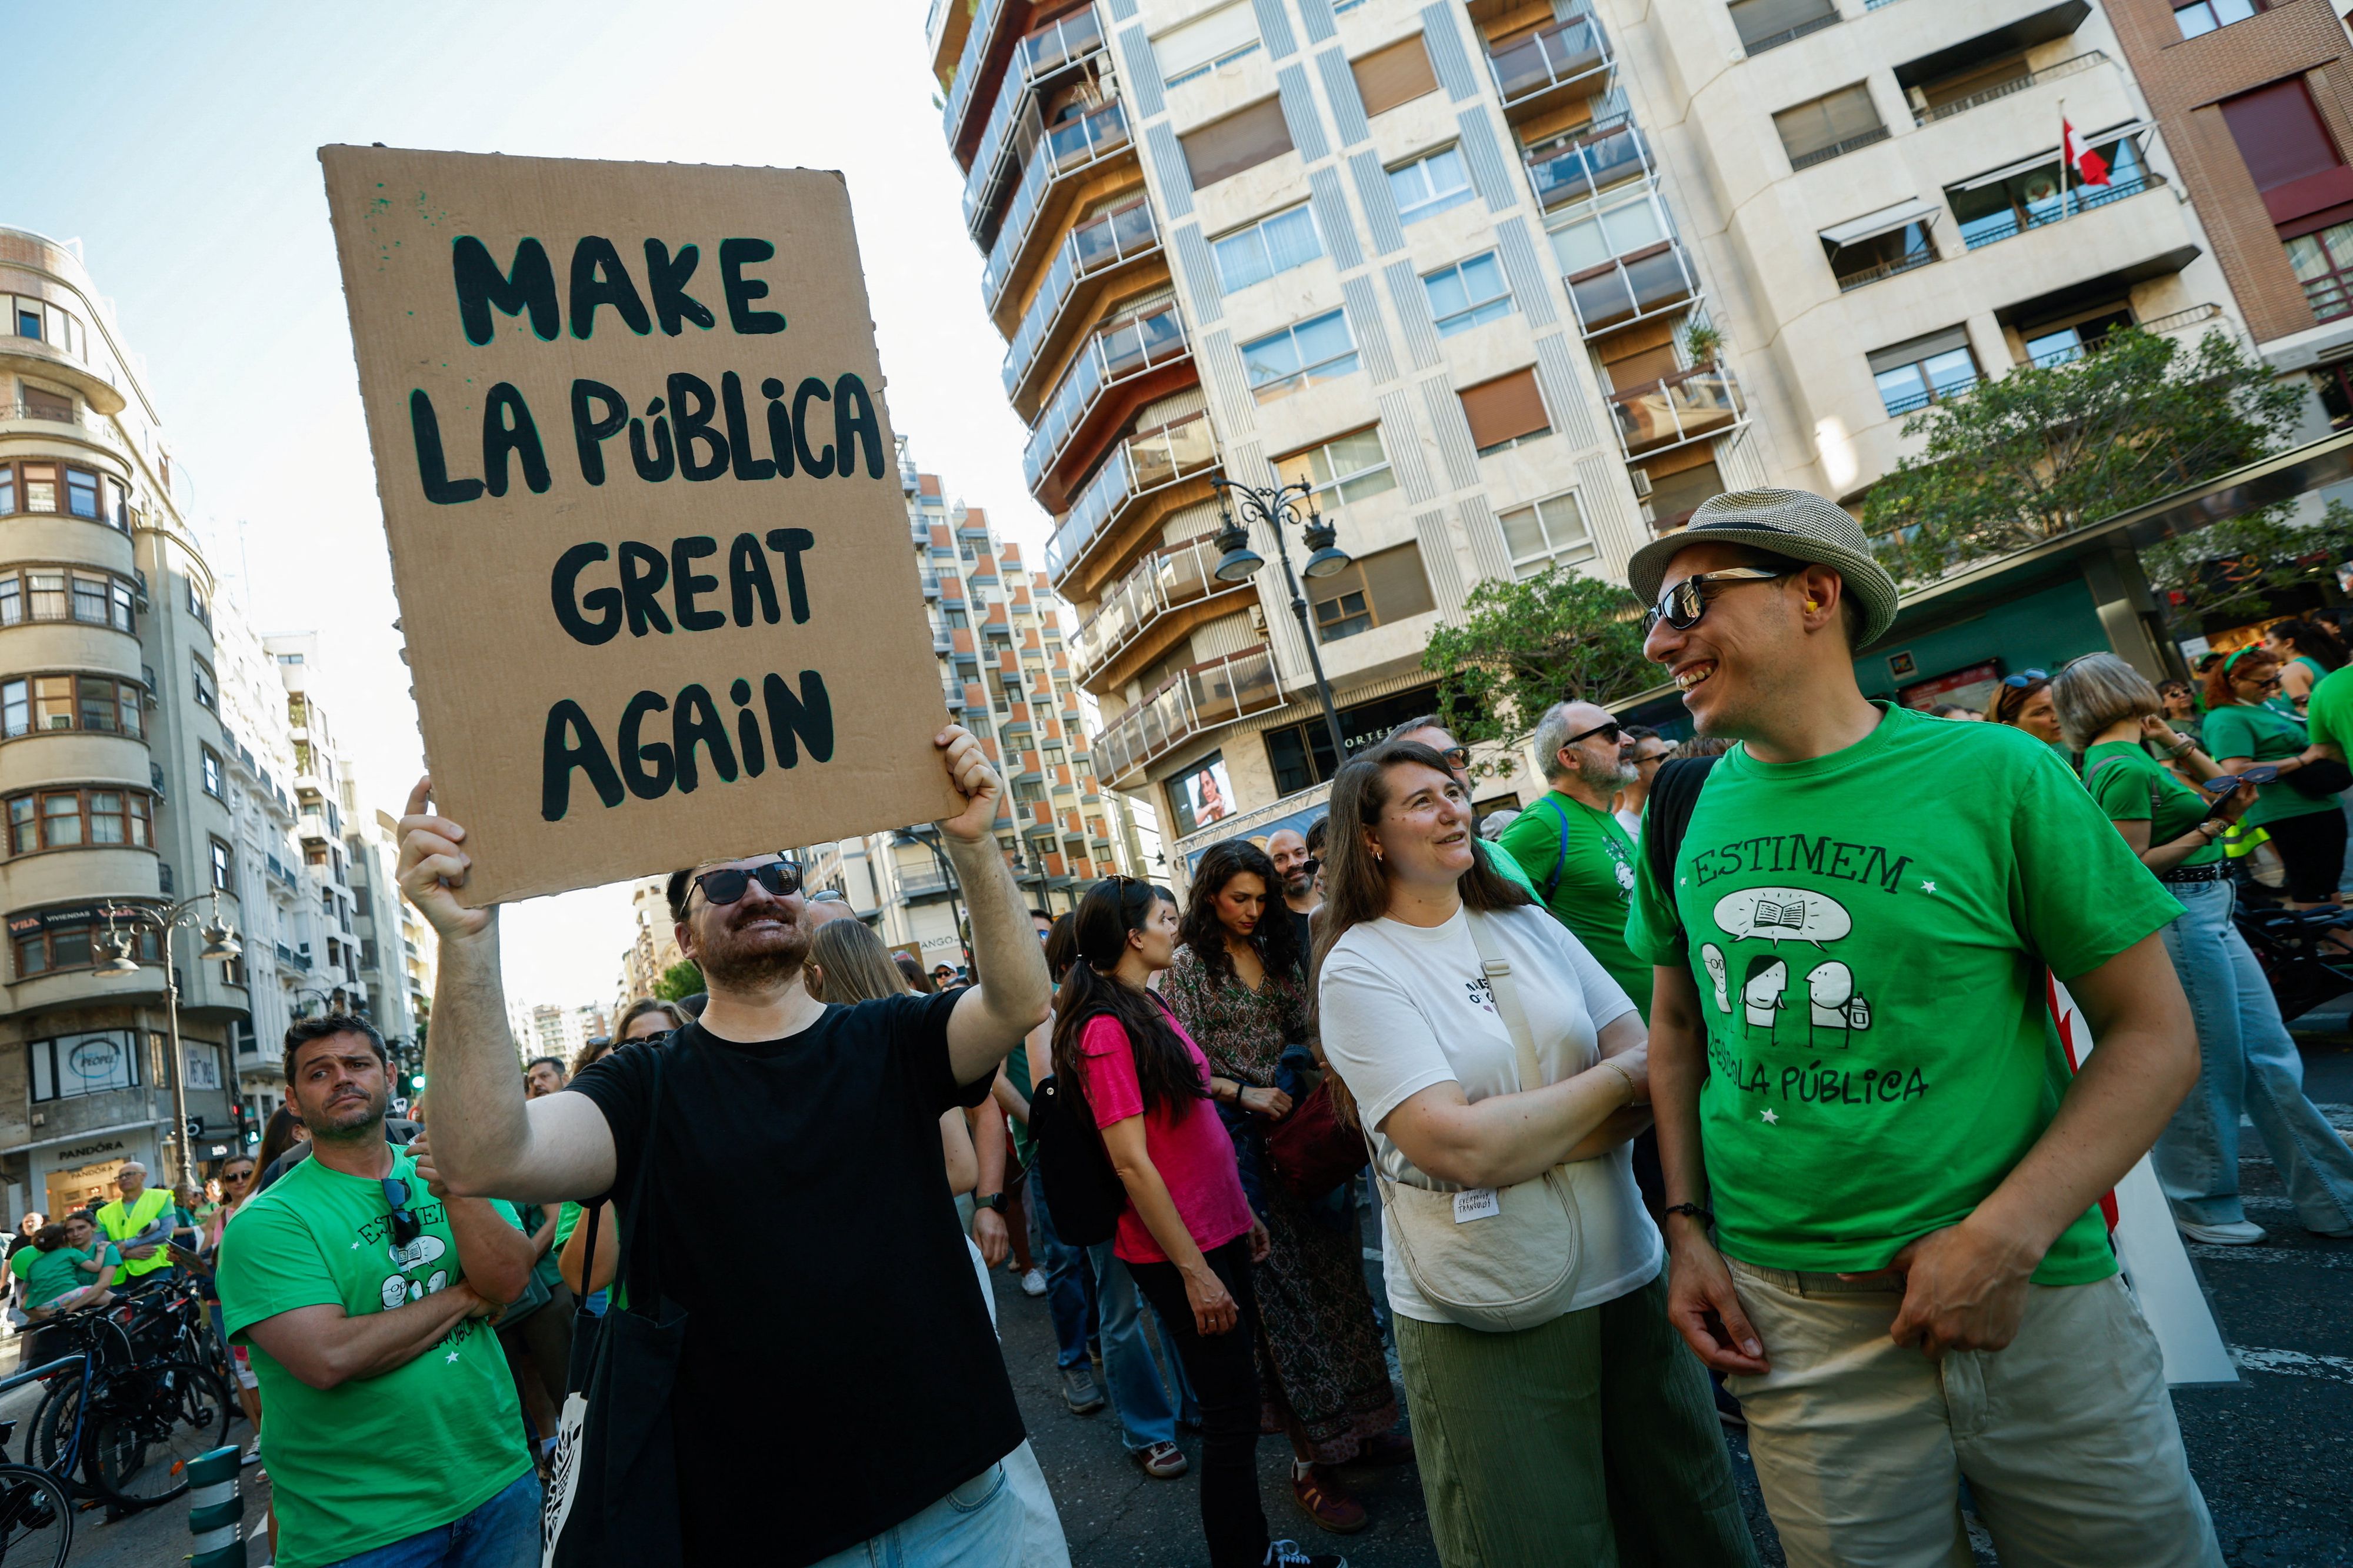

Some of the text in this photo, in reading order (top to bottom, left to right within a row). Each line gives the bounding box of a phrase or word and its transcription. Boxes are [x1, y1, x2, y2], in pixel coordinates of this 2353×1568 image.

[451, 235, 787, 346] MAKE
[410, 382, 551, 505] LA
[551, 528, 814, 646] GREAT
[1691, 833, 1914, 895] ESTIMEM
[46, 910, 91, 922] VIVIENDAS
[921, 936, 953, 949] ANGO
[1459, 1192, 1489, 1206] EVERYBODY
